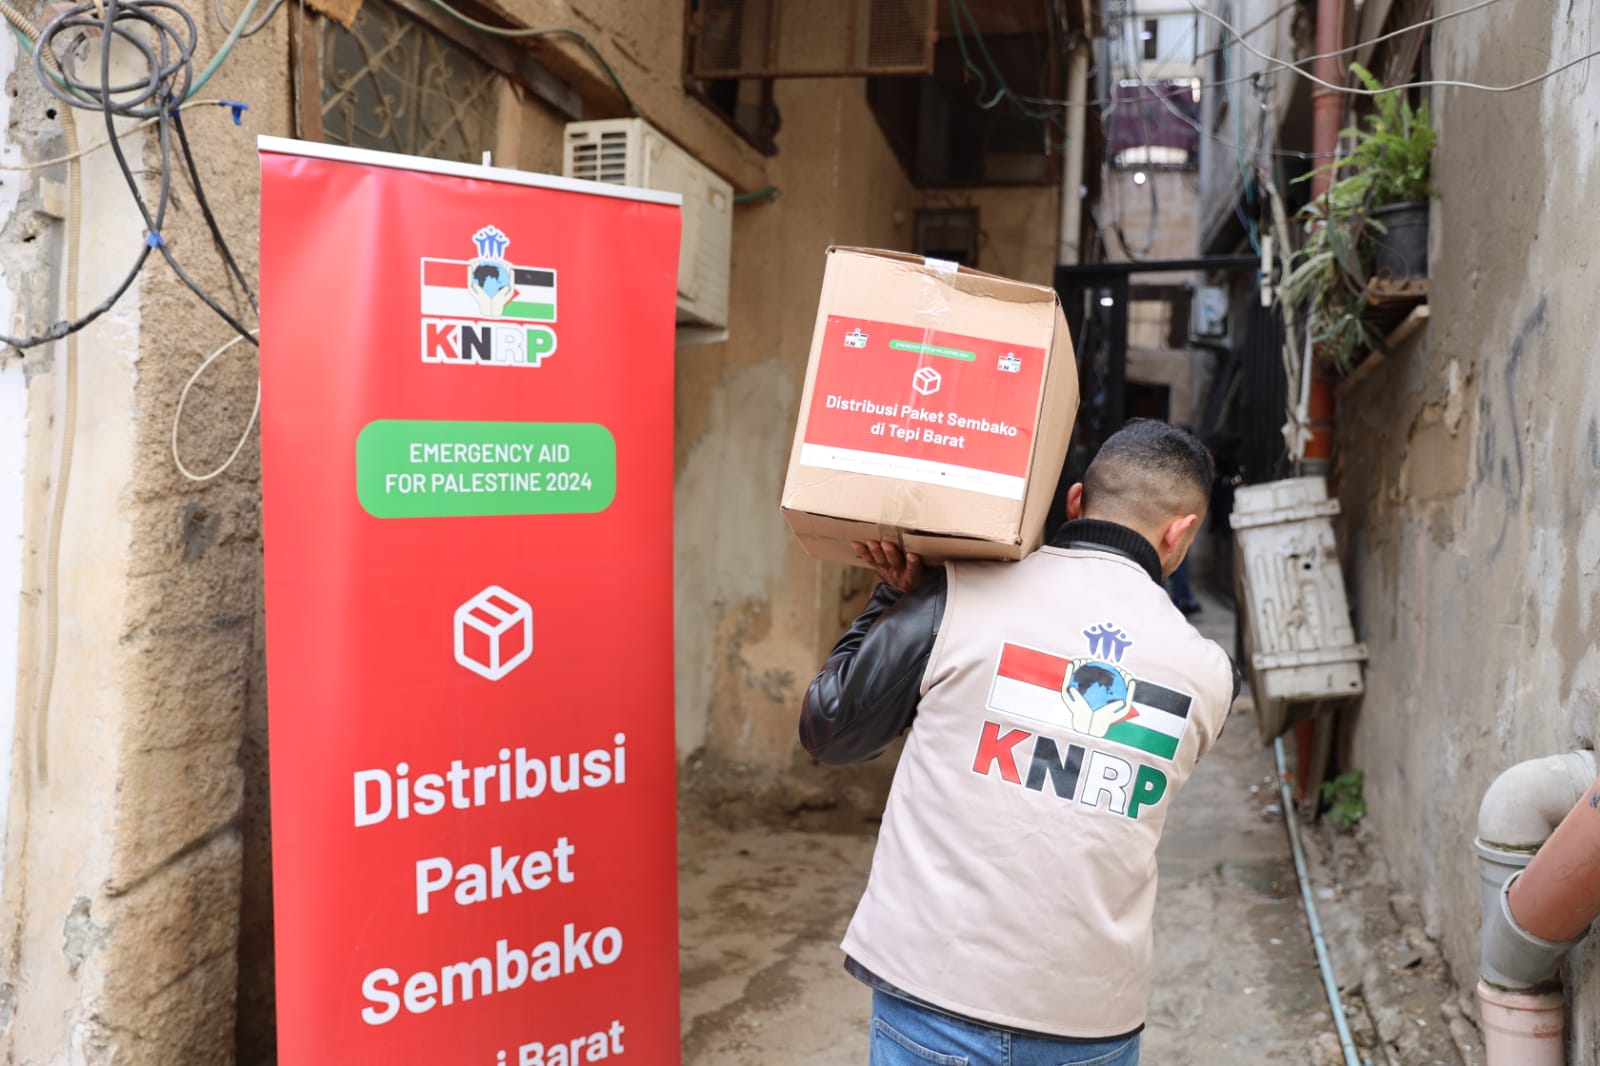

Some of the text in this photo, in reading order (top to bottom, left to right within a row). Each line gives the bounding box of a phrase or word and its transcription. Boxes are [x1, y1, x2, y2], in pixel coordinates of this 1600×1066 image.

[421, 319, 556, 366] KNRP
[826, 395, 1018, 437] Distribusi Paket Sembako
[870, 422, 966, 449] di Tepi Barat
[409, 443, 571, 464] EMERGENCY AID
[385, 472, 593, 494] FOR PALESTINE 2024
[353, 732, 627, 828] Distribusi
[970, 719, 1169, 820] KNRP
[415, 836, 575, 915] Paket
[361, 923, 624, 1026] Sembako
